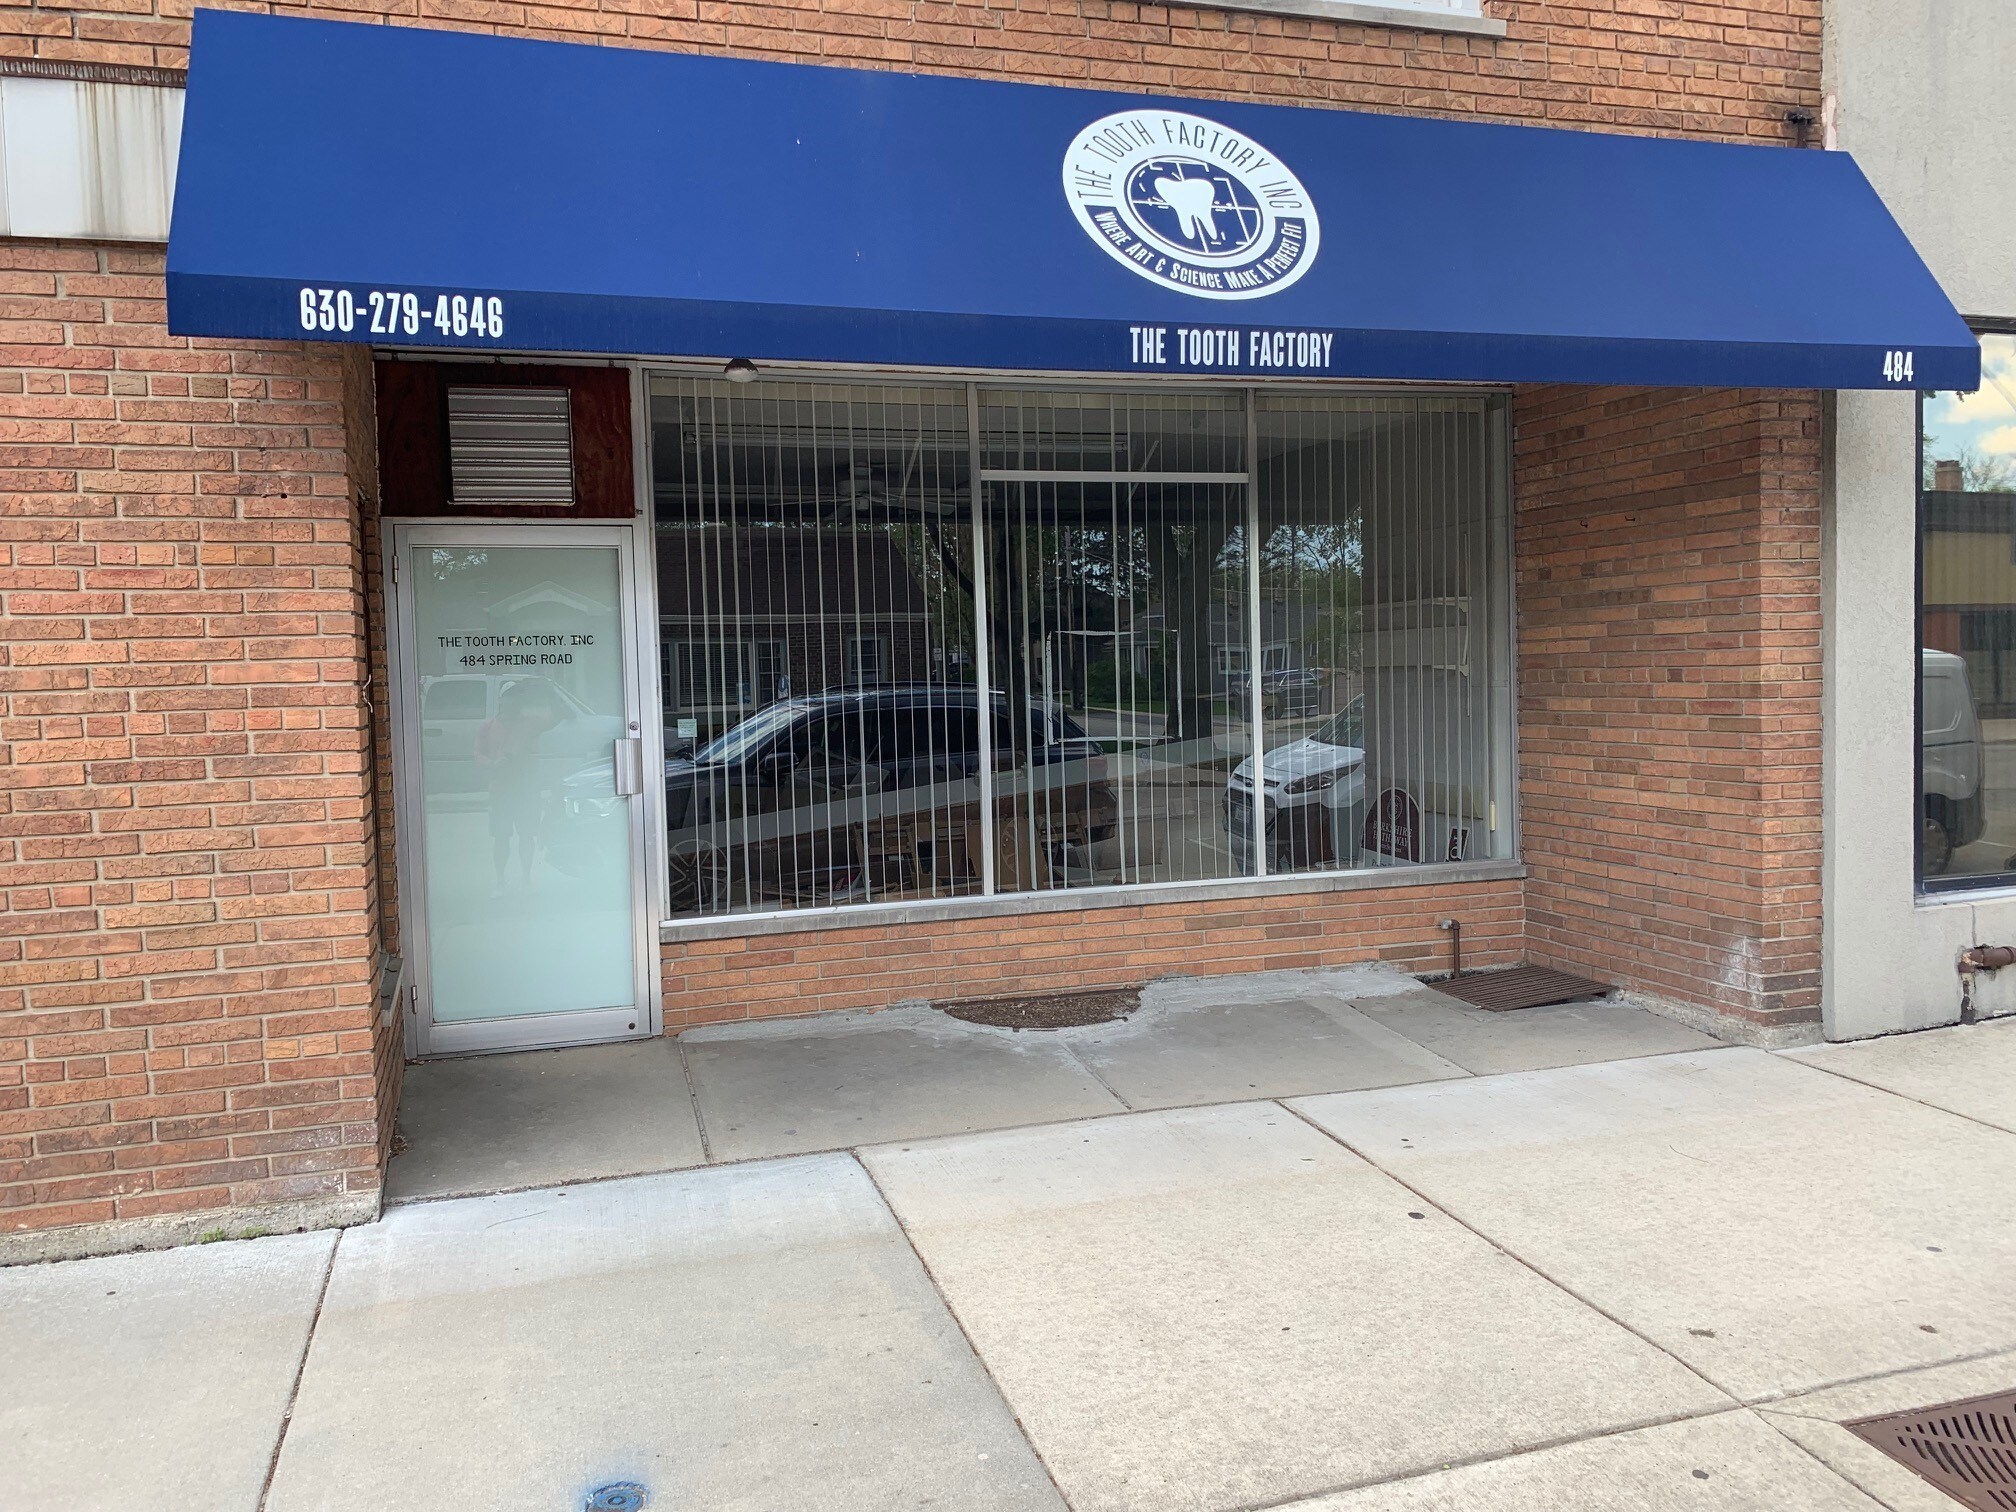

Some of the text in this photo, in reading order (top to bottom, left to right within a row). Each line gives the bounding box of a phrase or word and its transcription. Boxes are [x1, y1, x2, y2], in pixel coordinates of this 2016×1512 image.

[1075, 119, 1303, 209] THE TOOTH FACTORY INC
[1125, 242, 1155, 265] ART
[1155, 258, 1166, 273] &
[1256, 263, 1274, 280] A
[300, 287, 503, 338] 630-279-4646
[1129, 327, 1333, 368] THE TOOTH FACTORY
[1882, 350, 1914, 382] 484
[437, 636, 462, 647] THE
[465, 636, 505, 647] TOOTH
[570, 635, 594, 646] INC
[459, 653, 573, 666] 484 SPRING ROAD
